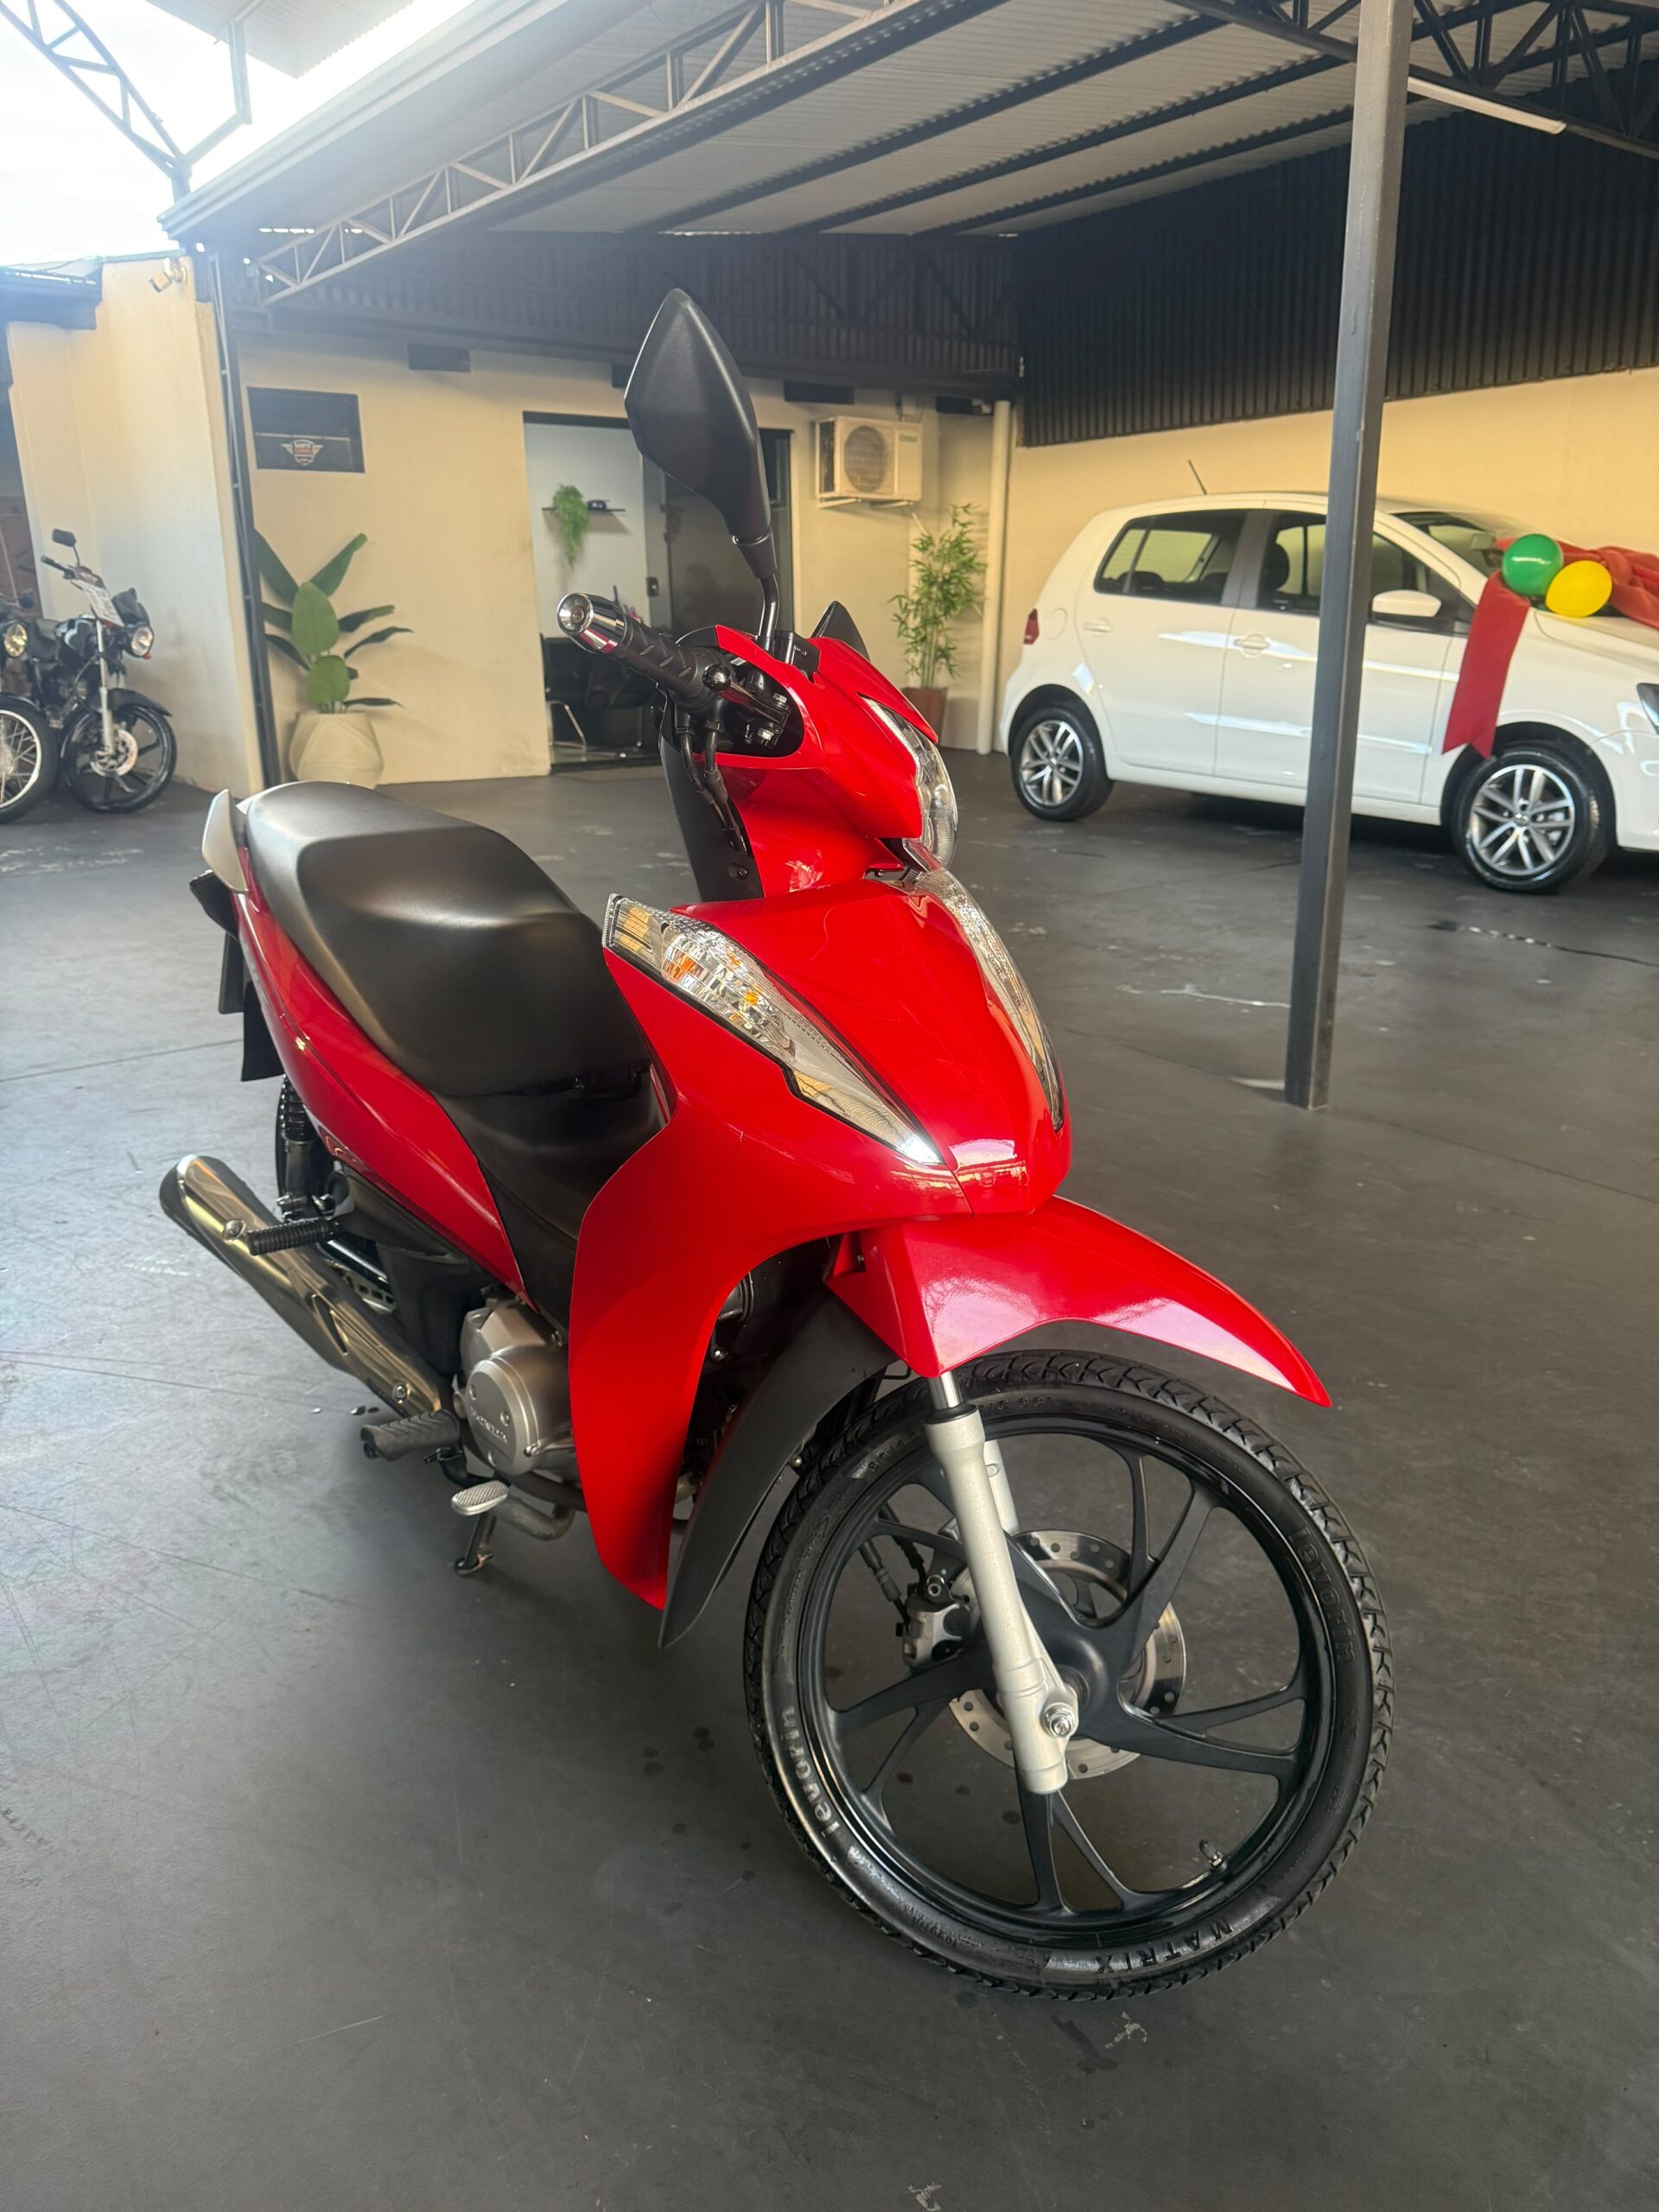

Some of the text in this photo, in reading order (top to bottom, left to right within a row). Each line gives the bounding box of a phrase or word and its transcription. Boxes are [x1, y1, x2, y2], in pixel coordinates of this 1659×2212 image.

[1288, 1526, 1356, 1662] levorin
[781, 1706, 841, 1839] levorin
[1094, 1918, 1233, 1974] MATRIX
